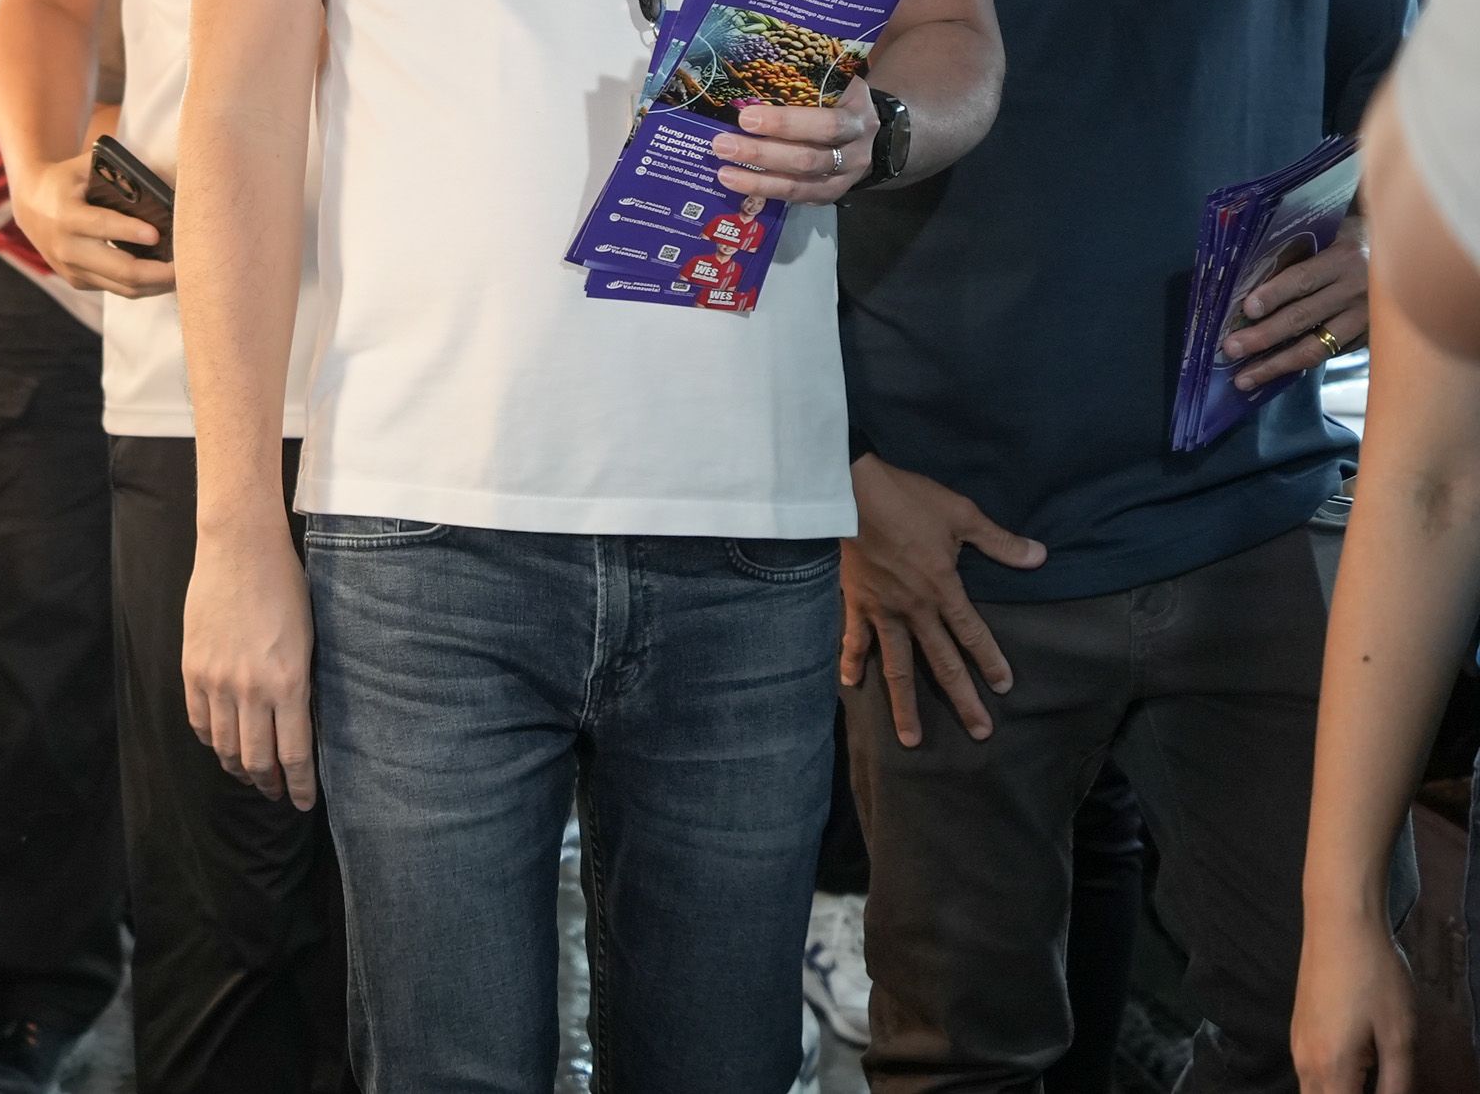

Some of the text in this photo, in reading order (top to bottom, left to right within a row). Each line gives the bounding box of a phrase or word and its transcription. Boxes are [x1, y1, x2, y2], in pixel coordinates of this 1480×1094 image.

[654, 133, 667, 141] sa
[658, 124, 684, 138] Kung
[687, 150, 704, 160] ito:
[683, 169, 699, 177] local
[717, 223, 741, 237] WES
[694, 264, 719, 277] WES
[709, 289, 733, 301] WES
